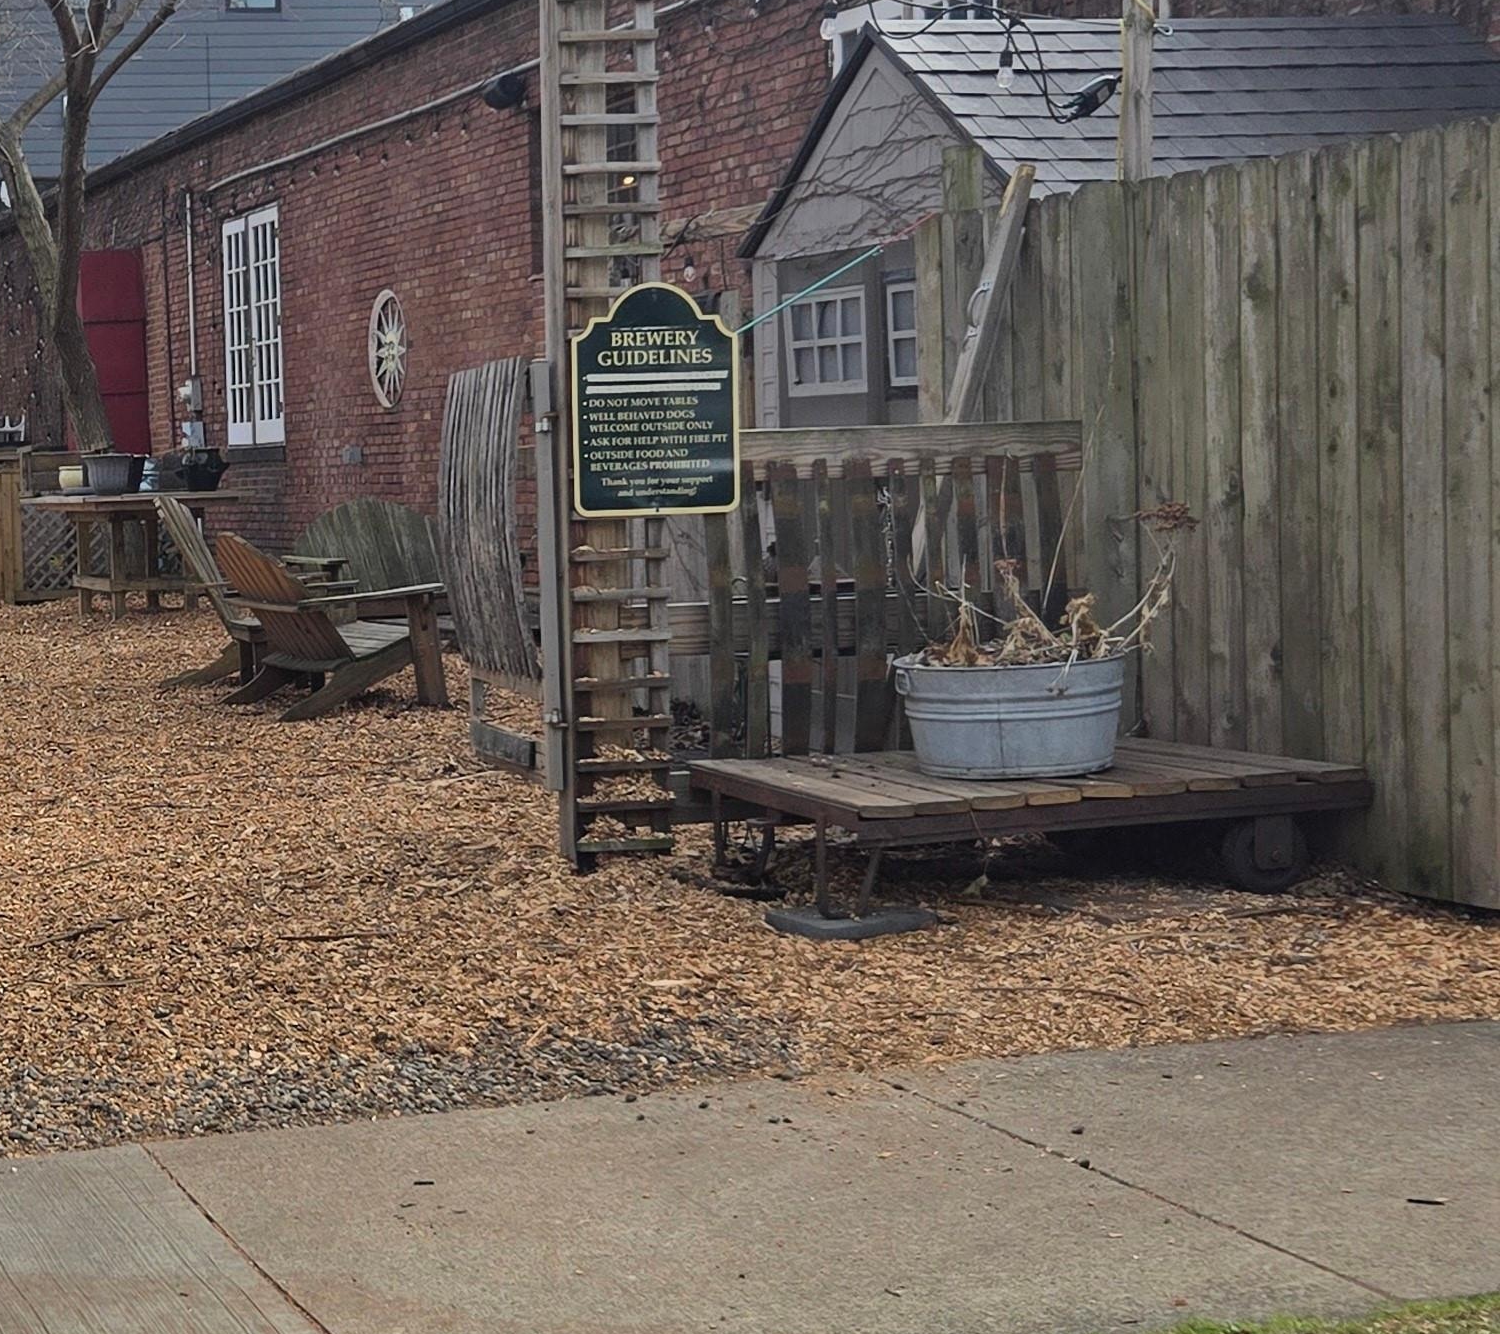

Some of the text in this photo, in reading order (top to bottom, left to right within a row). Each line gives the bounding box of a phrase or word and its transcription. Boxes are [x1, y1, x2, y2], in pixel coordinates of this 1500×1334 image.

[611, 330, 699, 348] BREWERY
[597, 349, 713, 366] GUIDELINES
[589, 397, 698, 407] DO NOT MOVE TABLES
[589, 410, 695, 421] WELL BEHAVED DOGS
[589, 421, 713, 432] WELCOME OUTSIDE ONLY
[590, 434, 727, 447] ASK FOR HELP WITH FIRE PIT
[590, 449, 688, 460] OUTSIDE FOOD AND
[591, 459, 709, 471] BEVERAGES PROHIBITED
[601, 478, 627, 486] Thank
[629, 478, 645, 487] you
[661, 477, 680, 487] your
[682, 476, 713, 485] support
[618, 489, 633, 497] and
